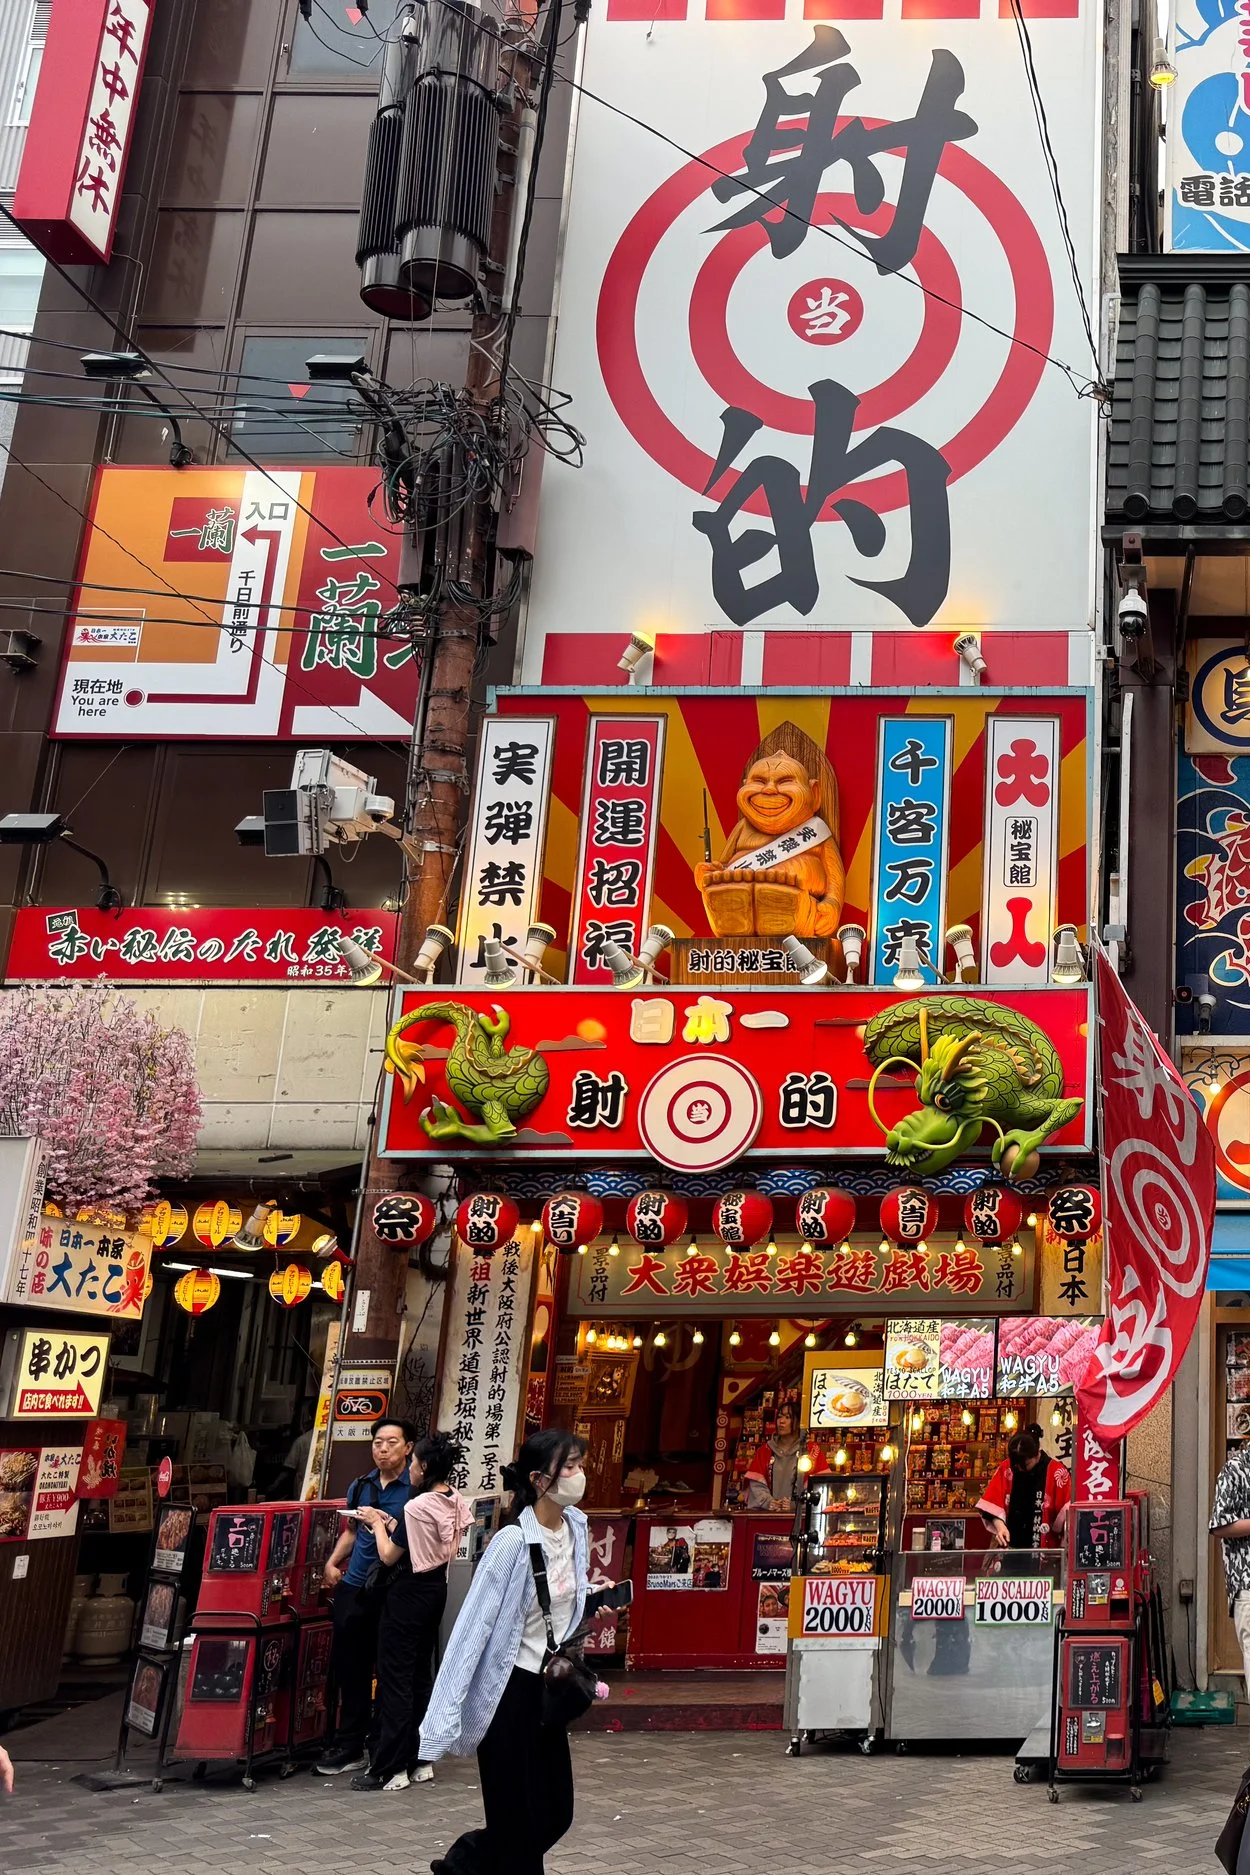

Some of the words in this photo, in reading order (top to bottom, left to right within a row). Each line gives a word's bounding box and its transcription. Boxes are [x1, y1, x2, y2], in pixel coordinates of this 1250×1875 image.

[77, 1, 139, 216] 年中無休
[692, 25, 979, 627] 射的
[799, 286, 852, 337] 当
[169, 507, 236, 555] 一蘭
[245, 500, 290, 522] 入口
[228, 569, 257, 655] 千日前通り
[300, 540, 388, 680] 一蘭
[70, 694, 94, 708] You
[96, 696, 119, 707] are
[72, 678, 124, 696] 現在地
[78, 705, 107, 717] here
[470, 740, 540, 970] 実弾禁止
[583, 737, 650, 972] 開運招福
[882, 737, 940, 968] 千客万来
[1009, 818, 1035, 886] 秘宝館
[628, 995, 790, 1046] 日本一
[568, 1069, 628, 1130] 射
[778, 1070, 839, 1129] 的
[689, 1101, 712, 1124] 当
[373, 1195, 424, 1241] 祭
[549, 1195, 580, 1244] 大当り
[898, 1189, 929, 1240] 大当り
[1048, 1187, 1096, 1235] 祭
[31, 1226, 55, 1296] 味の店
[59, 1228, 95, 1250] 日本一
[46, 1251, 124, 1304] 大たこ
[587, 1246, 610, 1303] 景品付
[619, 1243, 986, 1298] 大衆娯楽遊戯場
[993, 1240, 1016, 1300] 景品付
[886, 1320, 940, 1334] 北海道産
[28, 1337, 101, 1382] 串かつ
[477, 1240, 522, 1492] 戦後大阪府公認射的場第一号店
[885, 1373, 935, 1390] ほたて
[940, 1367, 990, 1386] WAGYU
[1000, 1354, 1060, 1375] WAGYU
[812, 1372, 828, 1426] ほたて
[871, 1371, 884, 1417] 北海道産
[886, 1389, 917, 1399] 1000
[940, 1382, 990, 1400] 和牛A5
[1000, 1374, 1061, 1393] 和牛A5
[336, 1428, 371, 1437] 大阪市
[60, 1453, 82, 1466] 大たこ
[1081, 1423, 1114, 1502] 阪名
[228, 1517, 249, 1548] エロ
[1089, 1510, 1110, 1545] エロ
[807, 1579, 874, 1606] WAGYU
[913, 1598, 955, 1618] 2000
[915, 1579, 963, 1599] WAGYU
[975, 1600, 1041, 1623] 1000
[1040, 1600, 1050, 1623] YEN
[977, 1581, 1000, 1600] EZO
[1001, 1579, 1051, 1601] SCALLOP
[805, 1606, 864, 1633] 2000
[863, 1606, 873, 1633] YEN
